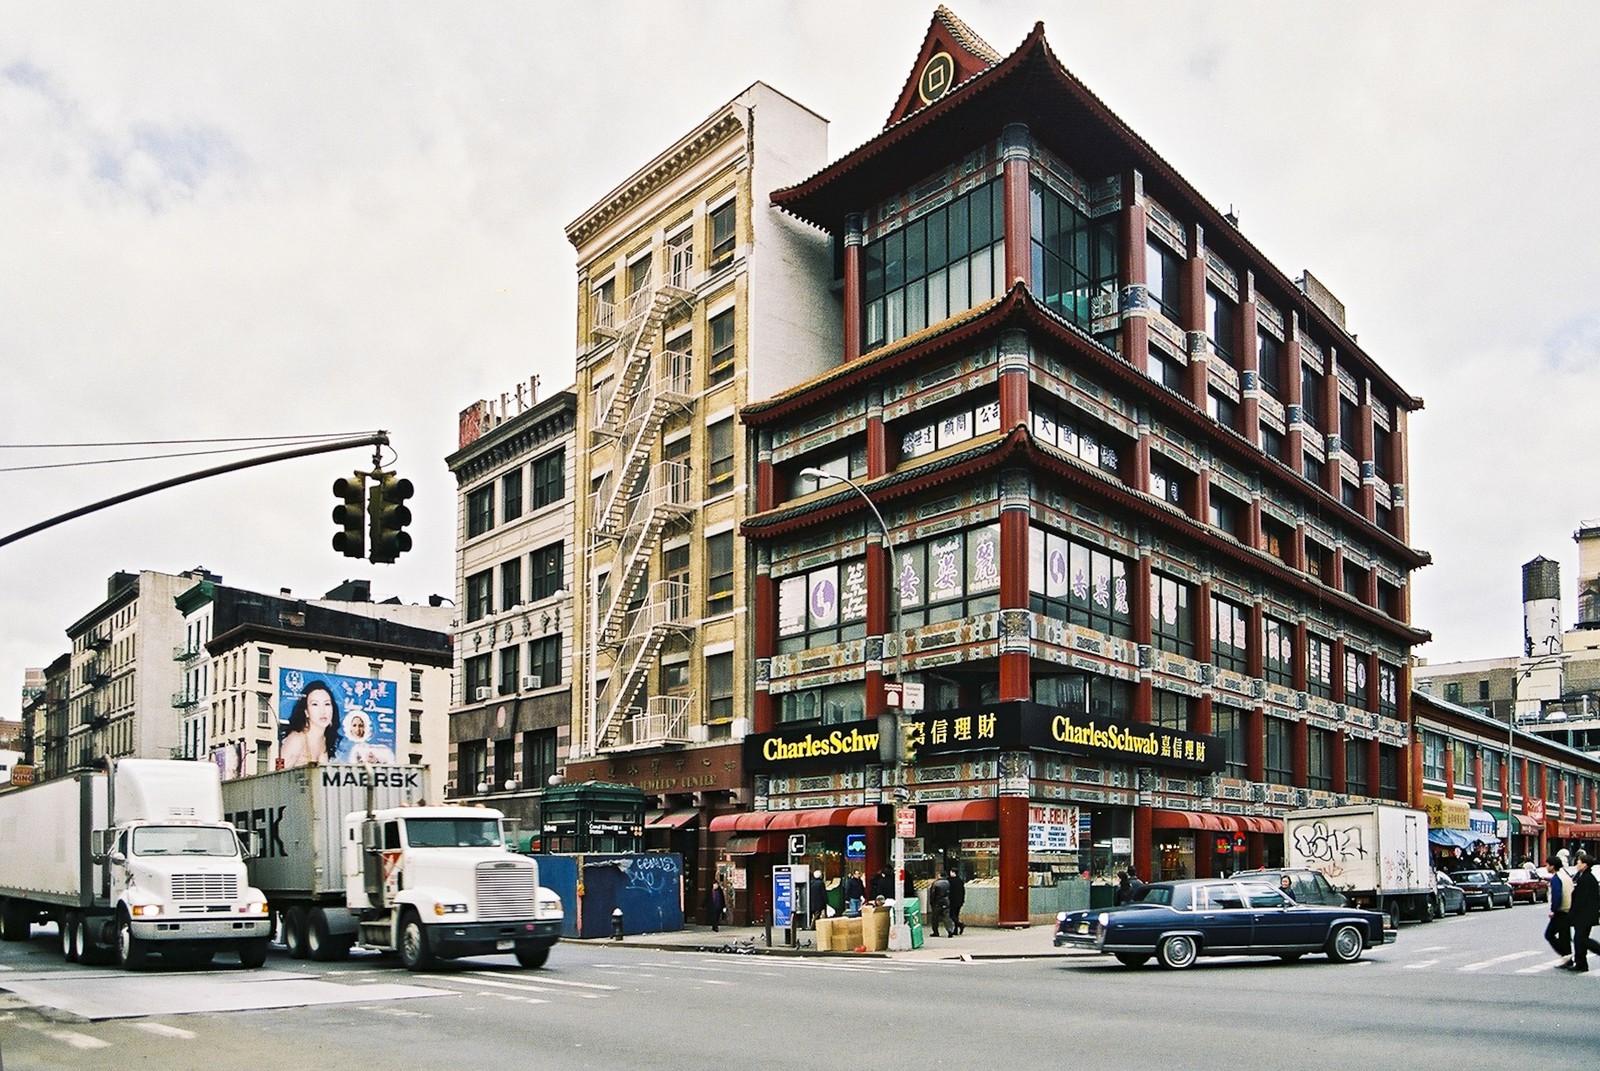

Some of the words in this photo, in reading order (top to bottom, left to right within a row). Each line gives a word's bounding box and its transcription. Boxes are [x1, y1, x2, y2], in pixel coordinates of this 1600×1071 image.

[763, 728, 880, 761] CharlesSchw
[1160, 735, 1206, 762] 嘉信理財
